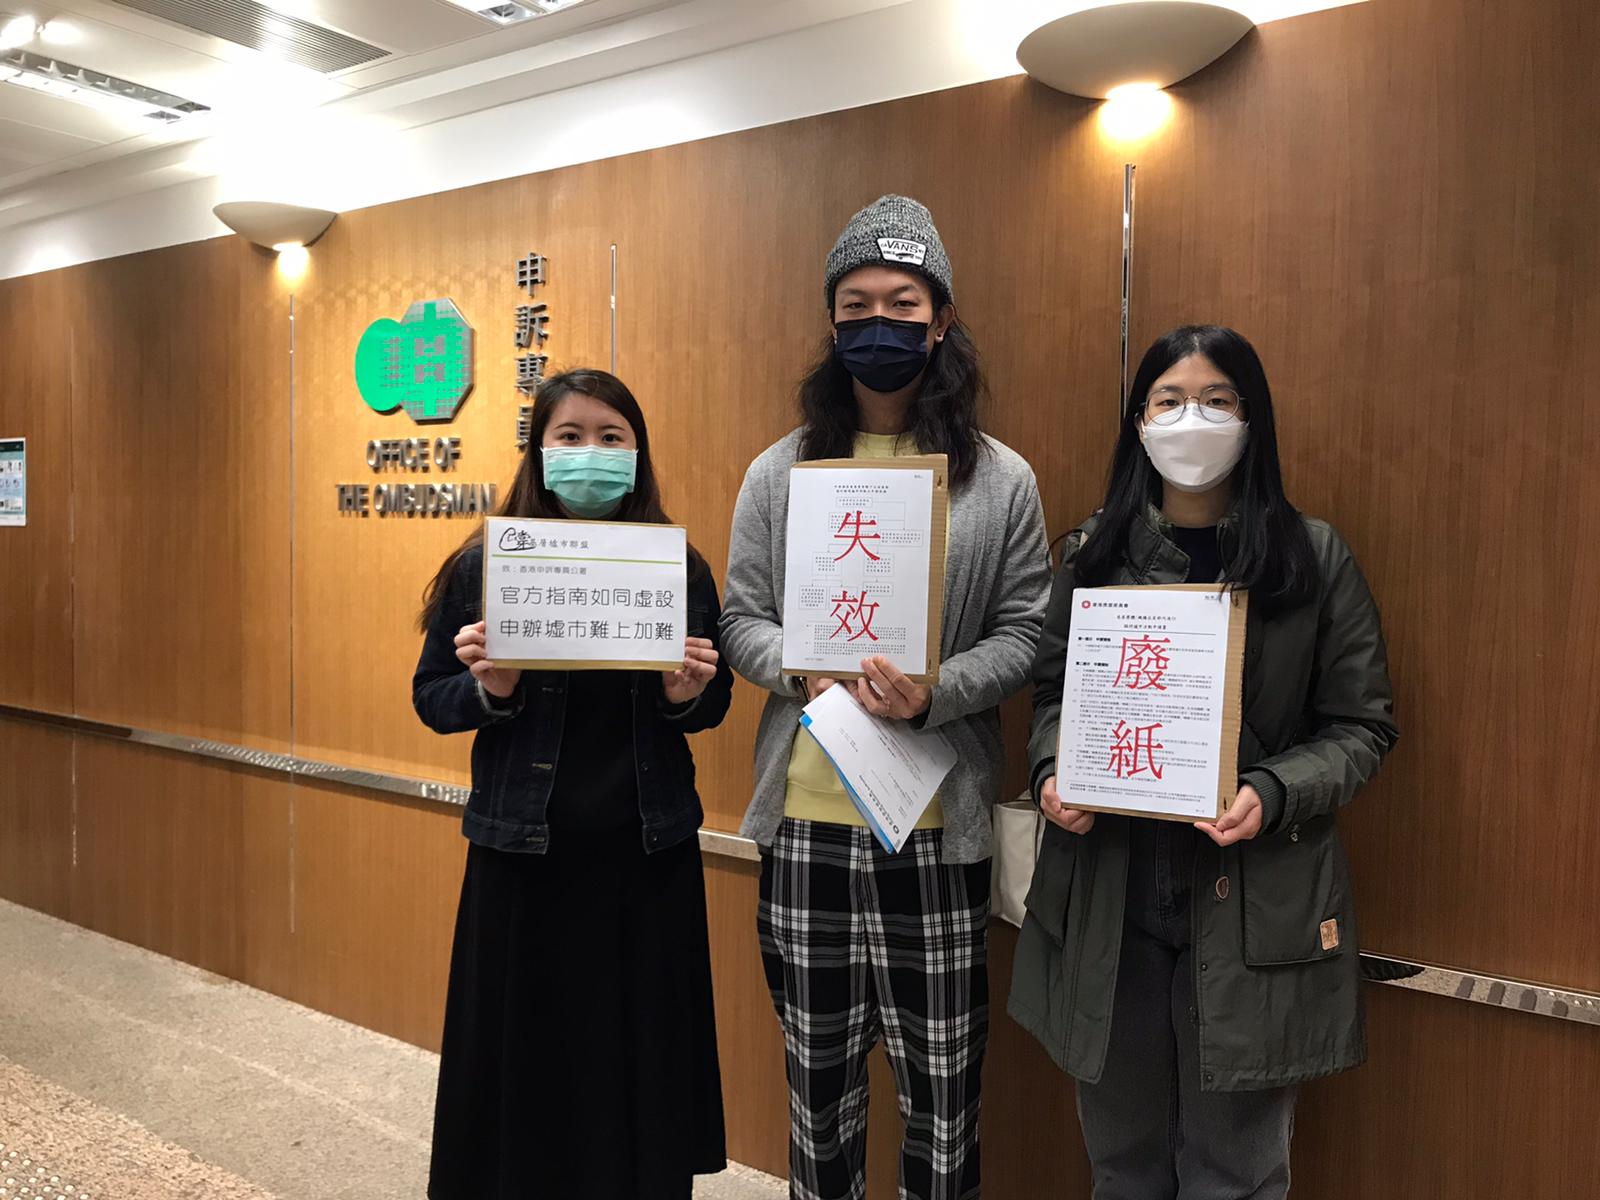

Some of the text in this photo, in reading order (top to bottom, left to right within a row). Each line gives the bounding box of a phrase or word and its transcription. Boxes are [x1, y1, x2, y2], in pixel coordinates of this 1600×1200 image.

[887, 240, 919, 253] VANS
[366, 437, 461, 470] OFFICE OF
[335, 484, 496, 513] THE OMBUDSMAN
[830, 510, 881, 642] 失效
[500, 585, 674, 609] 官方指南如同虛設
[500, 619, 674, 641] 申辦墟市難上加難
[1107, 634, 1171, 781] 廢紙
